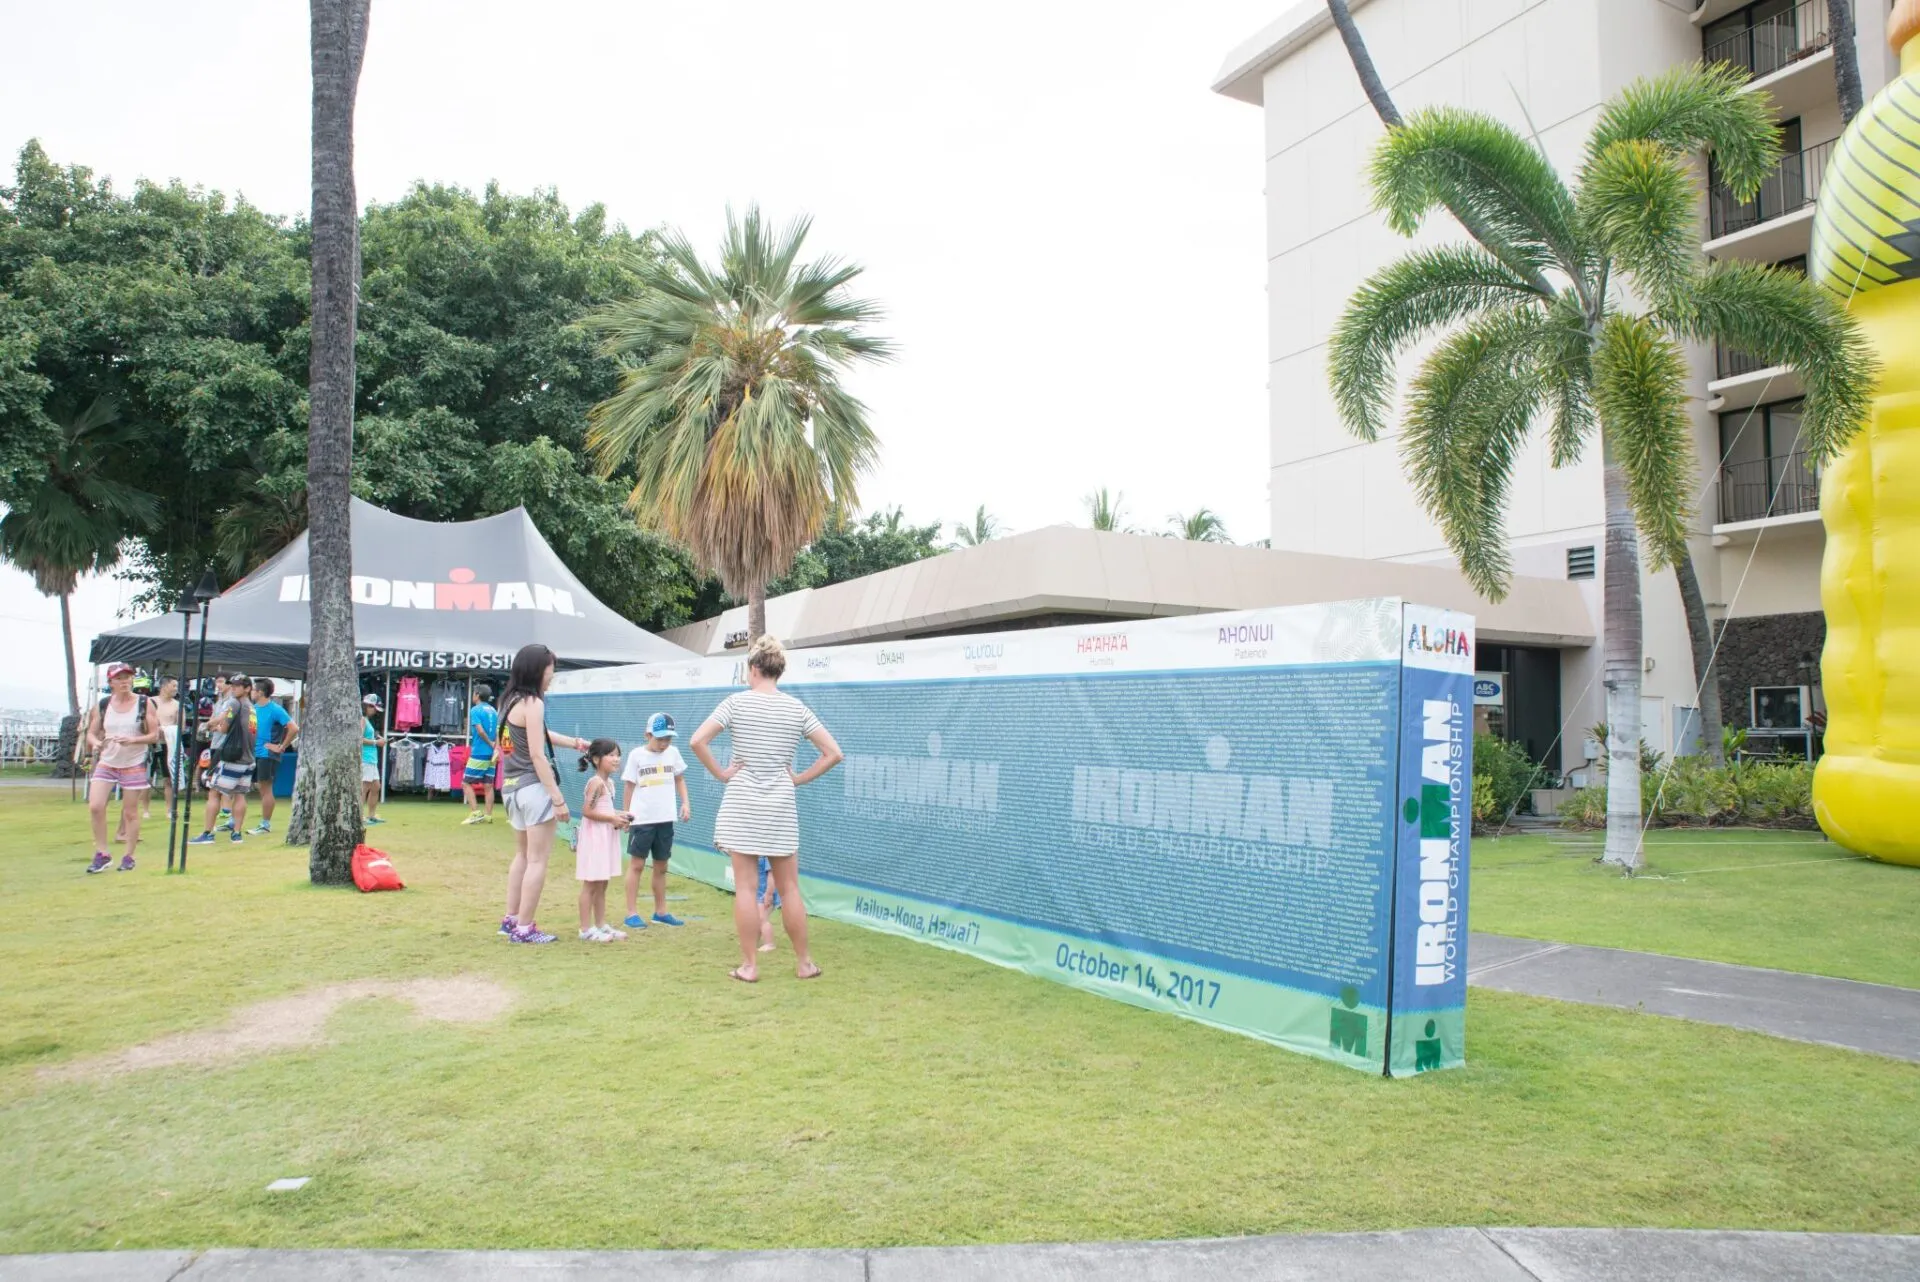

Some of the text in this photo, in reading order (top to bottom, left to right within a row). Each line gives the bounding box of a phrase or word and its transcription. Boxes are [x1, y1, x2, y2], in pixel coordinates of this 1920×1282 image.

[279, 567, 576, 616] IONMAN
[1217, 624, 1273, 644] AHONUI
[1408, 623, 1469, 656] ALOHA
[430, 651, 447, 668] IS
[453, 652, 515, 670] POSSI
[1476, 683, 1494, 691] ABC
[844, 731, 1000, 811] IRONMAN
[1072, 735, 1333, 850] IRONMAN
[1403, 699, 1451, 986] IRONMAN
[1444, 703, 1463, 982] WORLD CHAMPIONSHIP
[855, 896, 925, 934] Kailua-Kona,
[1056, 943, 1221, 1009] October 14, 2017
